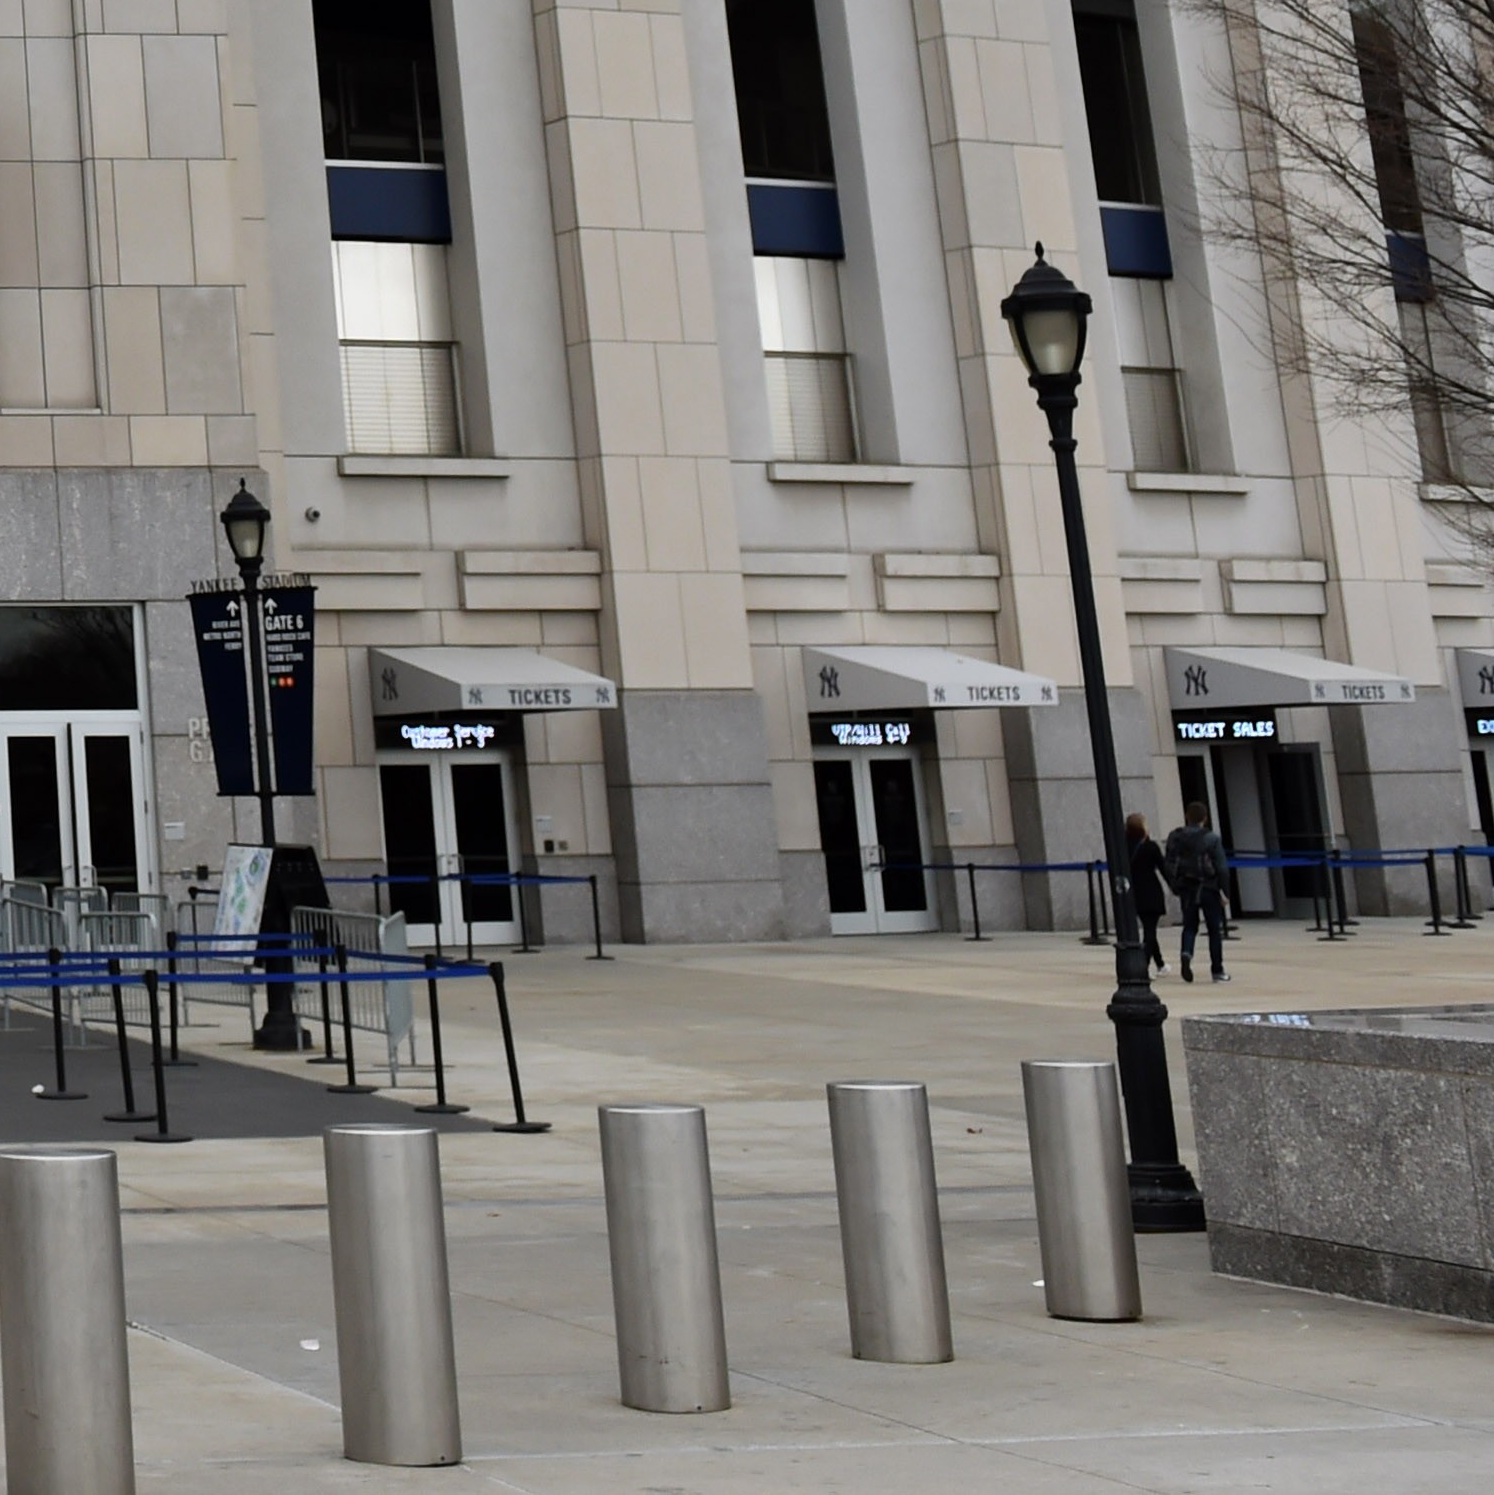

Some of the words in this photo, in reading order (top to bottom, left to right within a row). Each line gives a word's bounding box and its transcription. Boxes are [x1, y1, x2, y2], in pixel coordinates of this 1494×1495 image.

[191, 578, 238, 593] YANKEE
[262, 574, 311, 590] STADIUM
[265, 615, 294, 630] GATE
[296, 614, 304, 629] 6
[819, 666, 840, 698] NY
[1184, 664, 1209, 696] NY
[509, 688, 572, 705] TICKETS
[967, 685, 1021, 702] TICKETS
[1342, 684, 1386, 700] TICKETS
[1177, 721, 1226, 739] TICKET
[1232, 720, 1275, 738] SALES
